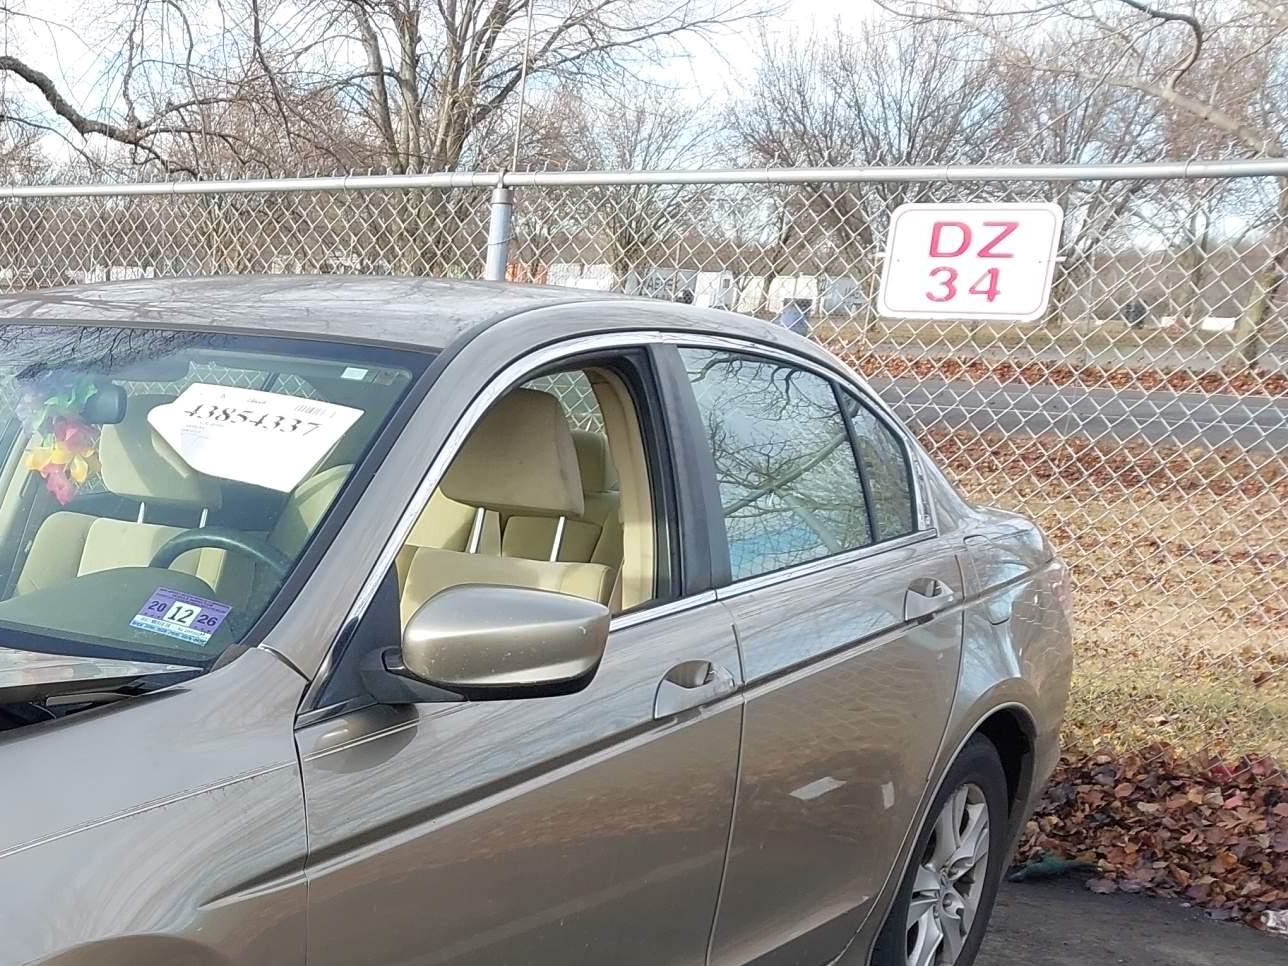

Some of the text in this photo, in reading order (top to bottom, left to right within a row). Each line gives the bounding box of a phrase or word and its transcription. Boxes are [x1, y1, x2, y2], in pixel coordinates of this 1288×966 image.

[929, 221, 1020, 259] DZ
[925, 266, 1002, 303] 34
[184, 403, 323, 437] 43854337
[148, 600, 168, 613] 20
[168, 605, 194, 624] 12
[197, 614, 218, 627] 26
